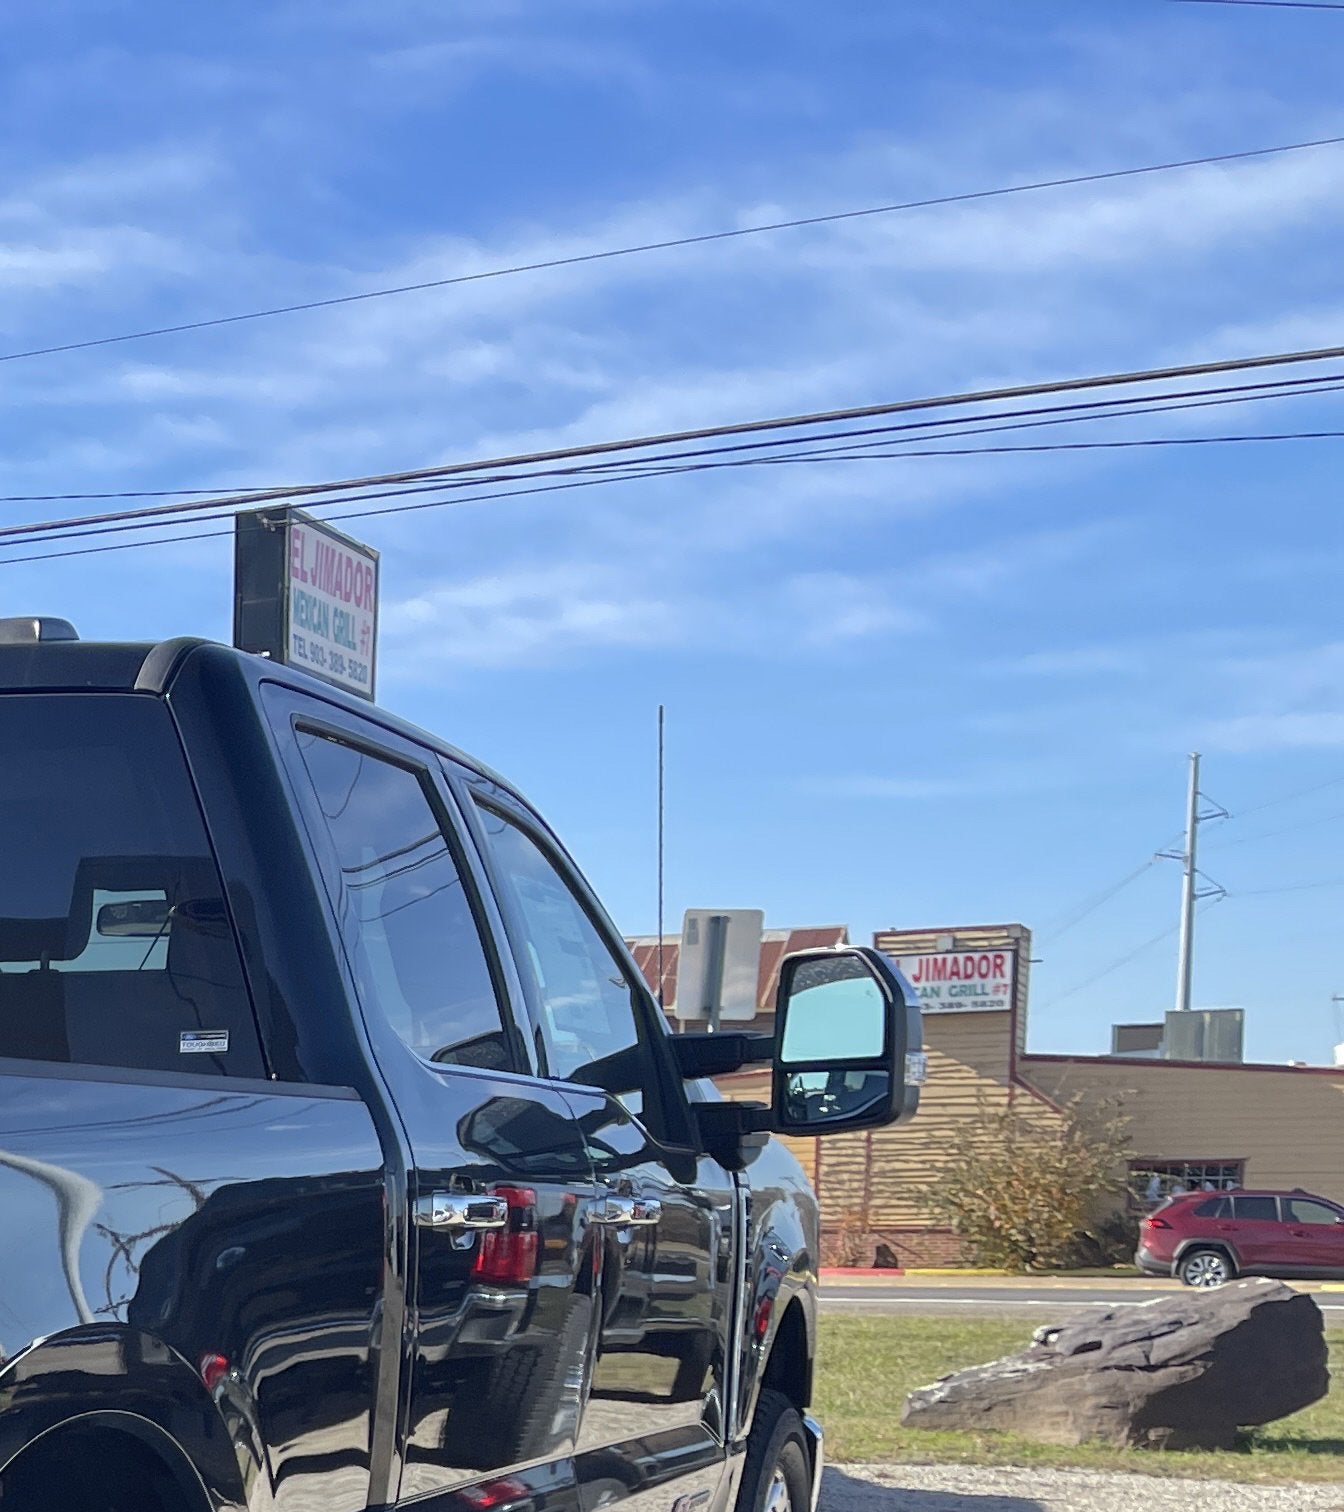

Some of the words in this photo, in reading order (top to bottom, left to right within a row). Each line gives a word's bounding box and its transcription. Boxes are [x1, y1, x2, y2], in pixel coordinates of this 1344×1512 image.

[291, 528, 308, 584] EL
[311, 540, 374, 612] JIMADOR
[912, 953, 1005, 983] JIMADOR
[948, 983, 989, 998] GRILL
